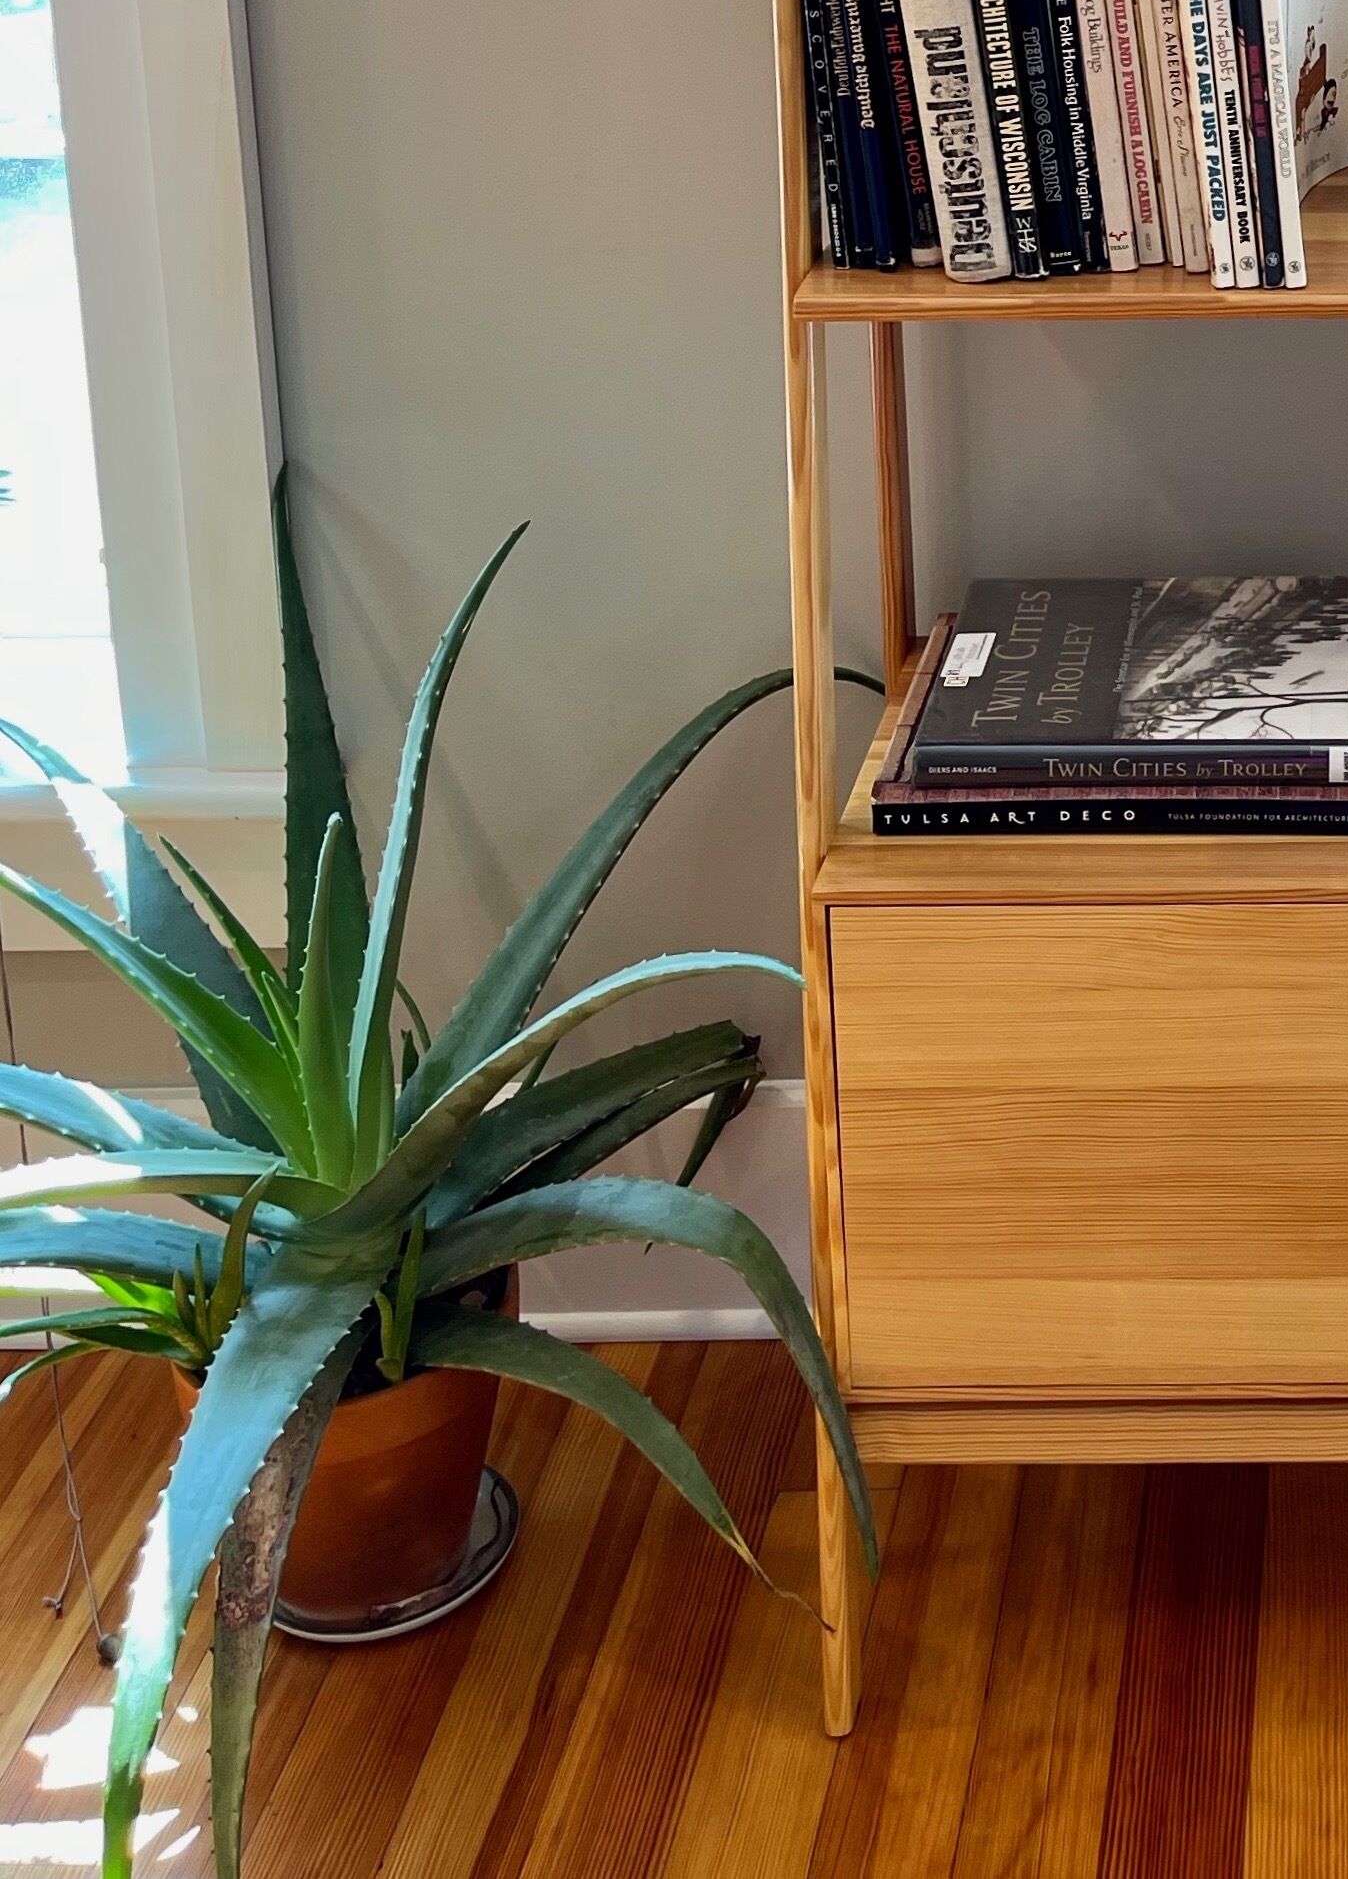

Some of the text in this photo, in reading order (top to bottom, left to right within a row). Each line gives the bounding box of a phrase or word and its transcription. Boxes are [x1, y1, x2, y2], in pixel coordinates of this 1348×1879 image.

[883, 23, 900, 54] THE
[1058, 16, 1074, 42] Folk
[1086, 16, 1103, 73] Buildings
[1117, 36, 1132, 66] AND
[1191, 21, 1210, 66] DAYS
[1061, 45, 1080, 104] Housing
[1164, 32, 1184, 109] AMERICA
[1199, 72, 1213, 104] ARE
[889, 58, 914, 135] NATURAL
[996, 93, 1020, 114] OF
[1022, 27, 1063, 202] THE LOG CABIN
[1070, 107, 1081, 122] in
[1121, 70, 1141, 135] FURNISH
[1224, 90, 1239, 127] TENTH
[1267, 20, 1292, 179] IT'S A MAGICAL WORLD
[914, 25, 997, 272] Deutschland
[1072, 123, 1087, 164] Middle
[1130, 139, 1142, 150] A
[1202, 109, 1218, 148] JUST
[904, 138, 926, 194] HOUSE
[999, 117, 1034, 212] WISCONSIN
[1132, 150, 1146, 178] LOG
[1228, 129, 1249, 208] ANNIVERSARY
[1077, 166, 1093, 220] Virginia
[1137, 180, 1153, 224] CABIN
[1204, 155, 1226, 222] PACKED
[1237, 210, 1251, 244] BOOK
[971, 589, 1052, 729] TWIN CITIES
[1036, 623, 1096, 727] by TROLLEY
[928, 766, 997, 774] DIERS AND ISAACS
[1043, 758, 1307, 779] TWIN CITIES by TROLLEY
[884, 809, 1137, 825] TULSA ART DECO
